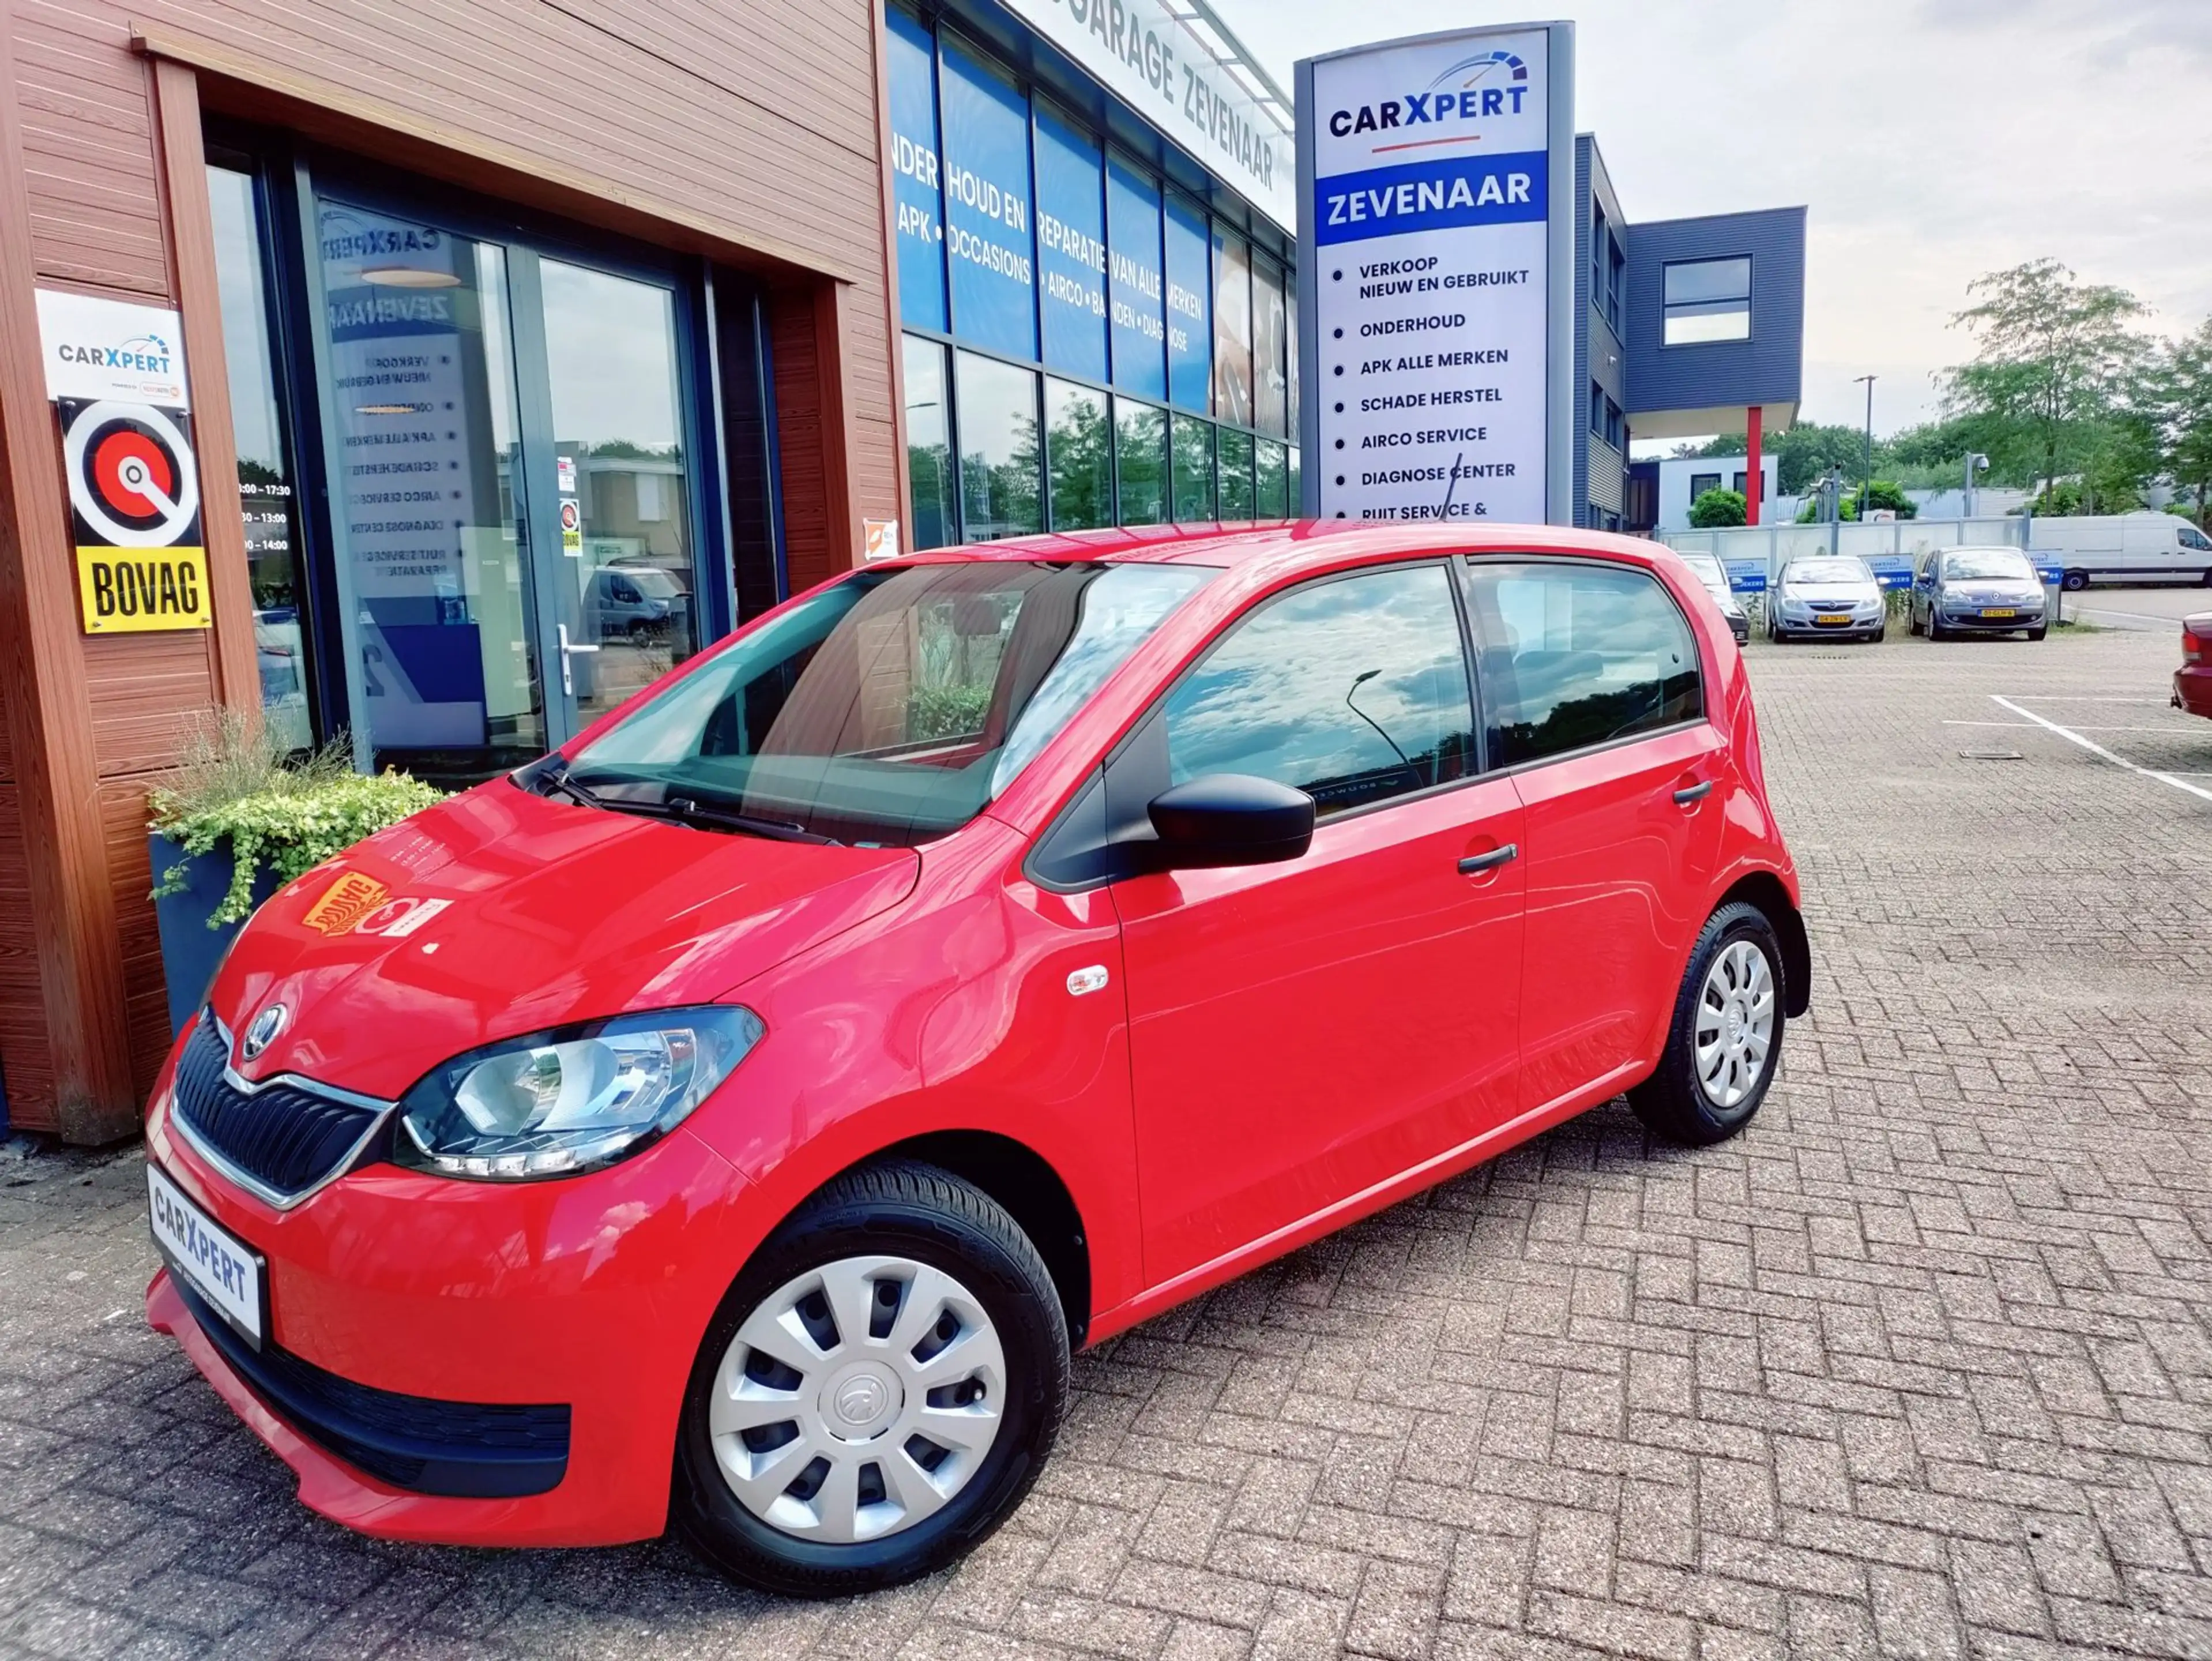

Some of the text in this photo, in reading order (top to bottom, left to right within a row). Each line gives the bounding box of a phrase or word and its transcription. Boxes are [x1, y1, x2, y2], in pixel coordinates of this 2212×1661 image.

[1052, 0, 1273, 192] ARAGE ZEVENAAR
[1330, 86, 1528, 137] CARXPERT
[1328, 173, 1531, 226] ZEVENAAR
[898, 202, 931, 243] APK
[1048, 270, 1083, 307] AIRCO
[1004, 191, 1025, 233] EN
[1111, 250, 1136, 288] VAN
[1139, 266, 1161, 301] ALLE
[1360, 257, 1438, 279] VERKOOP
[1360, 270, 1530, 299] NIEUW EN GEBRUIKT
[1360, 314, 1466, 337] ONDERHOUD
[59, 344, 170, 374] CARXPERT
[1360, 349, 1509, 375] APK ALLE MERKEN
[1361, 388, 1503, 412] SCHADE HERSTEL
[1361, 427, 1487, 449] AIRCO SERVICE
[1362, 464, 1516, 486] DIAGNOSE CENTER
[265, 485, 291, 495] 17:30
[261, 513, 287, 523] 13:00
[1362, 502, 1487, 519] RUIT SERVCE &
[262, 540, 288, 550] 14:00
[92, 561, 199, 617] BOVAG
[155, 1186, 246, 1303] CARXPERT
